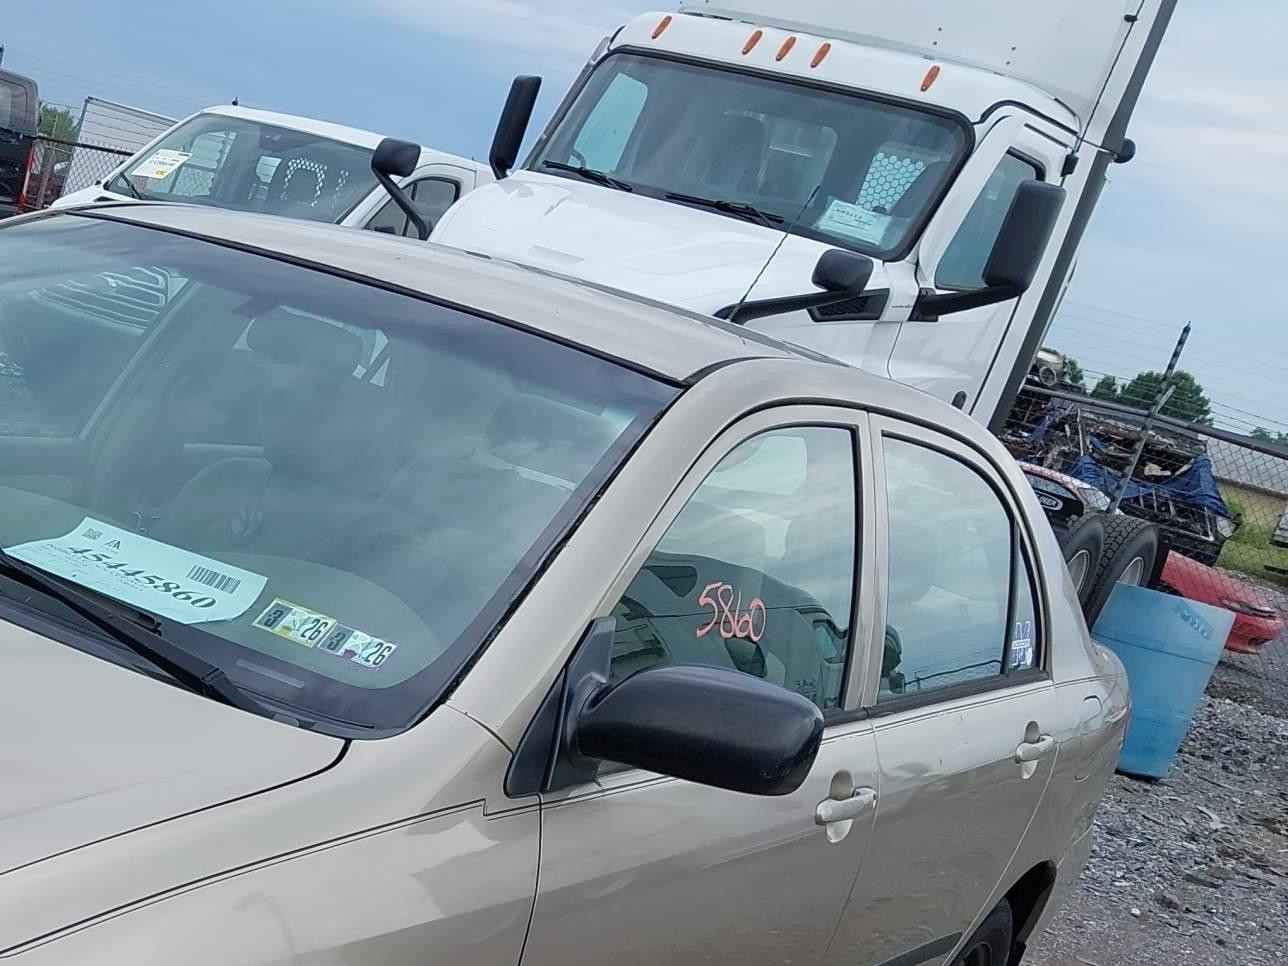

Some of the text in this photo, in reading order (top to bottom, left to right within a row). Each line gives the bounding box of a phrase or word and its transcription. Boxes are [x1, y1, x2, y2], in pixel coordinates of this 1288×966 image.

[68, 547, 216, 608] 45445860
[263, 609, 329, 641] 3 26
[696, 581, 766, 642] 5860
[326, 632, 393, 666] 3 26
